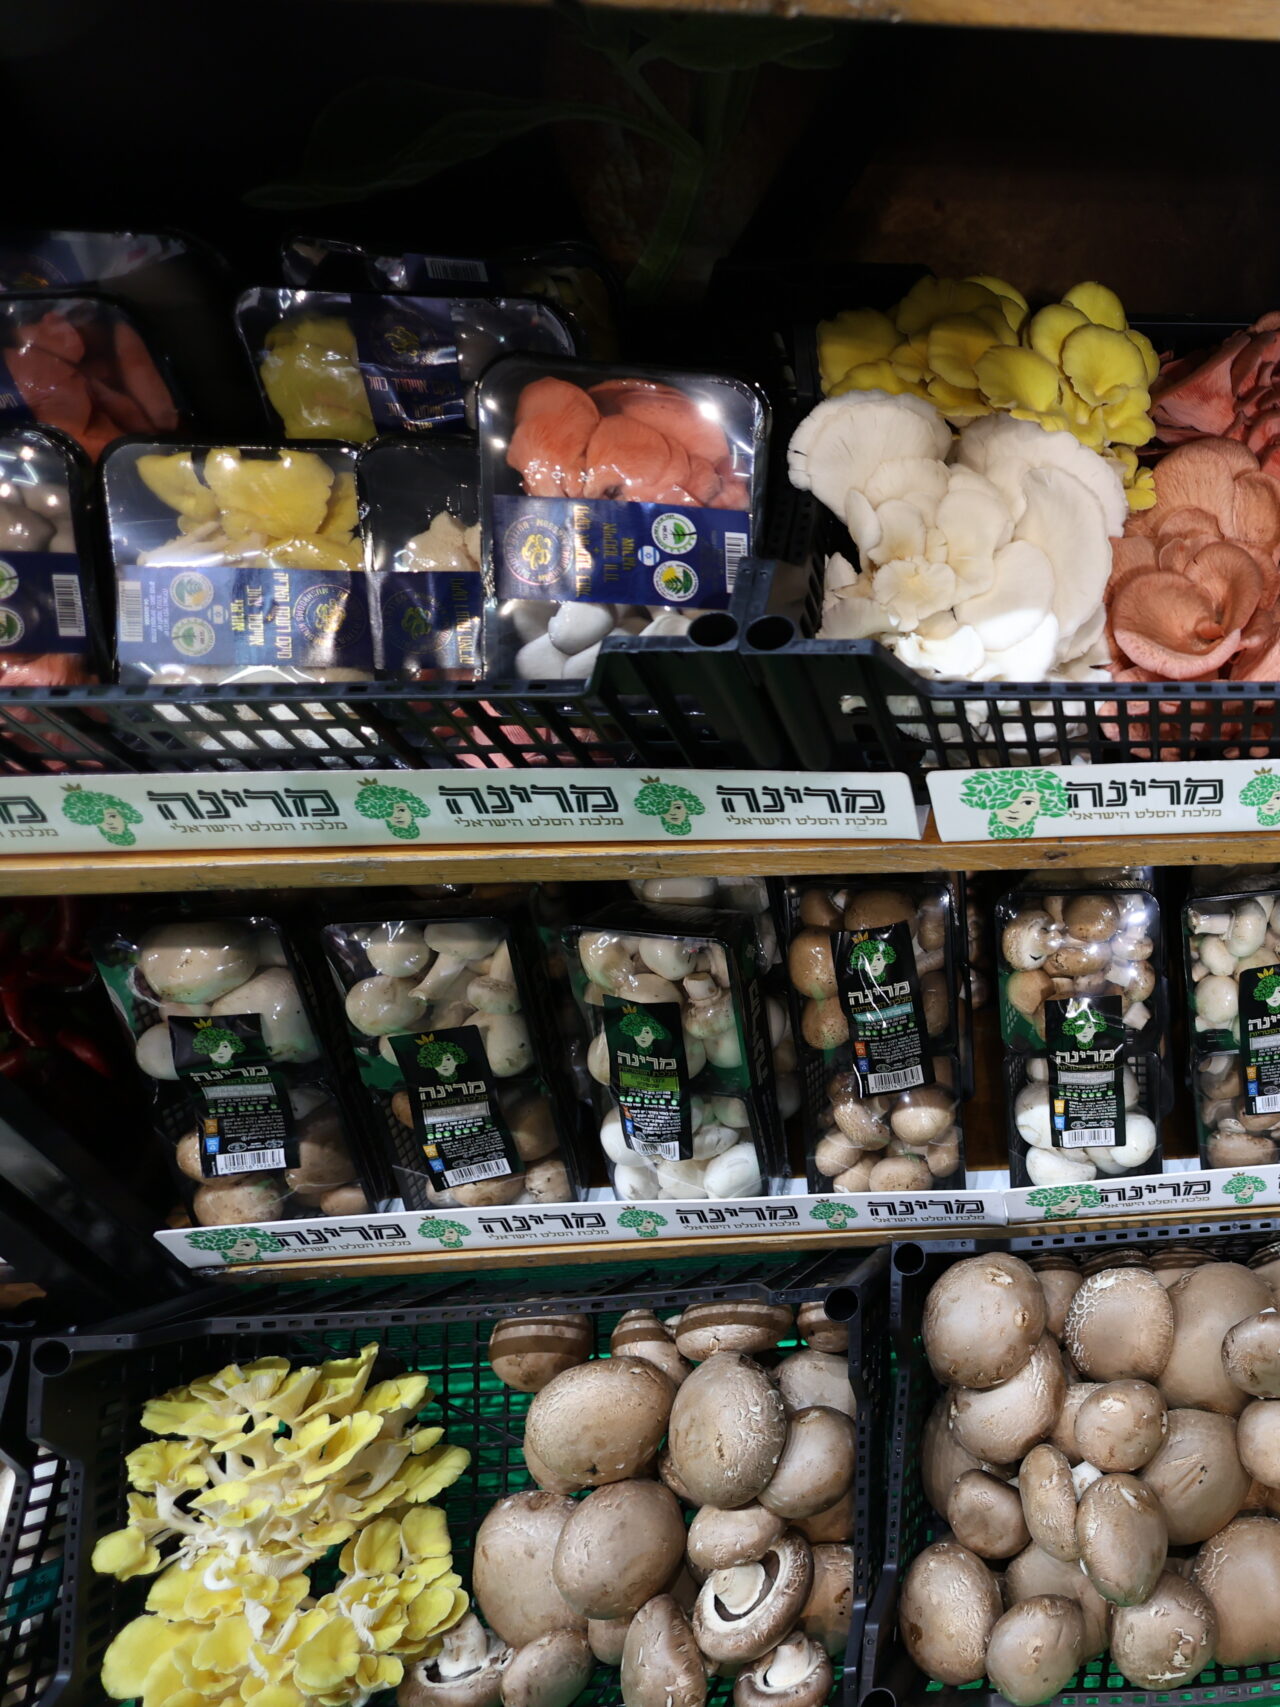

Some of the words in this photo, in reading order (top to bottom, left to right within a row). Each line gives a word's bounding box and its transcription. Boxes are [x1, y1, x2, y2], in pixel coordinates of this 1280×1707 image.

[573, 505, 592, 530] מיקס
[602, 522, 618, 558] אויסטר
[622, 538, 636, 570] אורגני
[604, 564, 619, 582] ורוד
[246, 585, 263, 606] צהוב
[274, 572, 290, 602] האריה
[575, 575, 592, 597] כחול
[230, 600, 245, 632] אורגני
[276, 606, 292, 632] רעמת
[248, 612, 264, 646] אויסטר
[275, 636, 292, 658] מיקס
[456, 636, 474, 664] האריה
[438, 784, 618, 814] מרינה
[716, 785, 886, 814] מרינה
[1064, 778, 1224, 808] מרינה
[147, 788, 340, 820] מרינה
[1134, 809, 1176, 819] הסלט
[1183, 809, 1222, 818] מלכת
[302, 820, 348, 831] מלכת
[455, 817, 523, 828] הישראלי
[528, 817, 573, 827] הסלט
[579, 816, 624, 826] מלכת
[726, 816, 792, 827] הישראלי
[797, 817, 840, 826] הסלט
[844, 818, 887, 826] מלכת
[1068, 810, 1130, 821] הישראלי
[10, 827, 59, 838] מלכת
[171, 823, 243, 834] הישראלי
[248, 822, 295, 833] הסלט
[848, 981, 910, 1006] מרינה
[1249, 1028, 1280, 1038] הפטריות
[617, 1050, 677, 1070] מרינה
[1056, 1050, 1115, 1064] מרינה
[190, 1066, 269, 1082] מרינה
[418, 1080, 486, 1100] מרינה
[1100, 1180, 1211, 1202] מרינה
[676, 1206, 798, 1224] מרינה
[867, 1200, 985, 1216] מרינה
[478, 1212, 606, 1234] מרינה
[270, 1224, 407, 1247] מרינה
